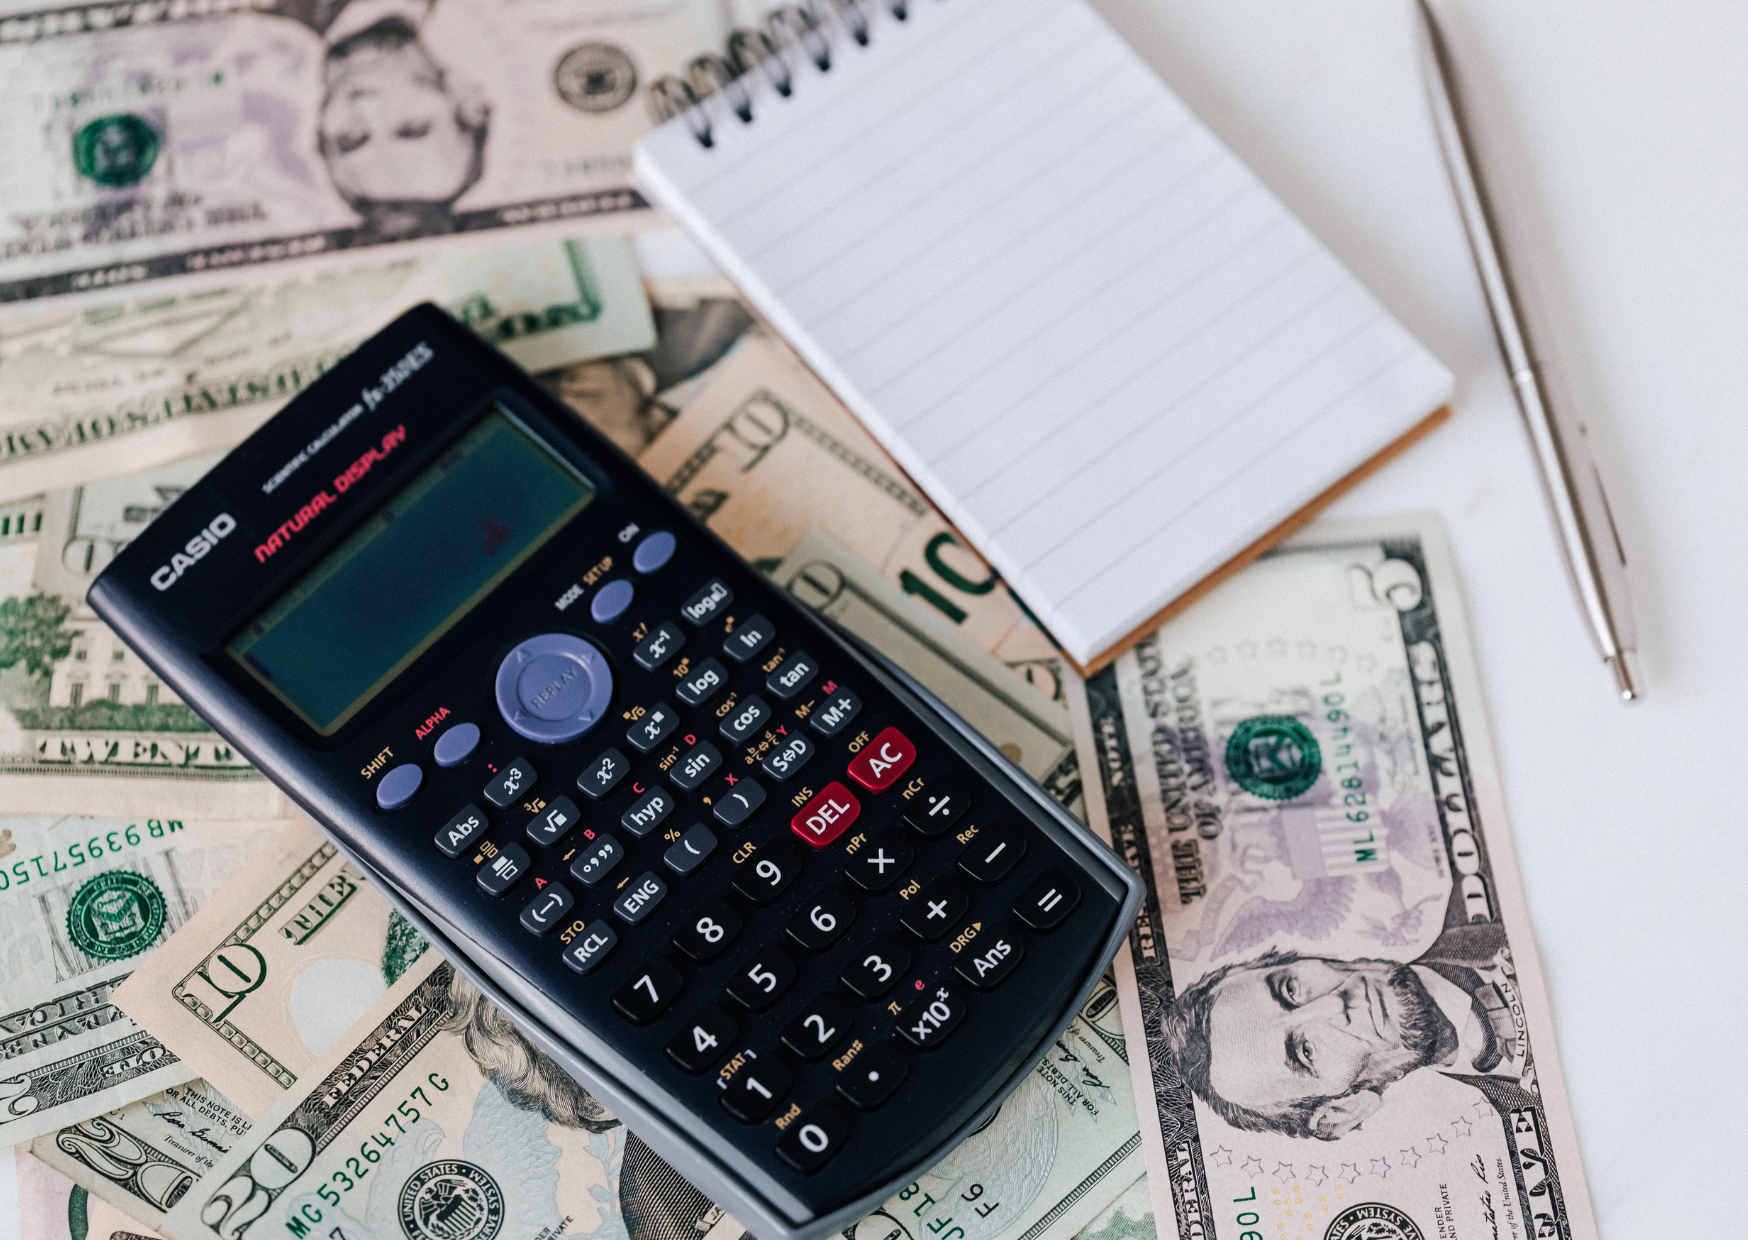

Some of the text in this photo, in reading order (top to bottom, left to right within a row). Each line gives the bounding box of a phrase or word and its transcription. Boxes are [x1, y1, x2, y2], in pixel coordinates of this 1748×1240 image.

[254, 424, 406, 563] NATURAL DISPLAY
[618, 522, 640, 543] ON
[150, 512, 237, 591] CASIO
[899, 532, 997, 625] 10
[1351, 557, 1423, 613] 5
[554, 583, 584, 611] MODE
[531, 665, 579, 710] REPLAY
[687, 668, 720, 695] log
[779, 661, 810, 688] tan
[822, 680, 838, 694] M
[415, 706, 451, 741] ALPHA
[734, 704, 761, 731] cos
[822, 695, 852, 727] M+
[684, 734, 697, 746] D
[776, 725, 789, 737] Y
[848, 731, 870, 753] OFF
[36, 735, 235, 768] TWENT
[361, 747, 394, 780] SHIFT
[684, 752, 710, 778] sin
[869, 742, 903, 778] AC
[633, 782, 645, 794] C
[902, 776, 926, 801] nCr
[1408, 640, 1492, 923] DOLLARS
[791, 787, 813, 808] INS
[630, 797, 664, 827] hyp
[806, 798, 850, 836] DEL
[447, 815, 480, 847] Abs
[583, 829, 596, 841] B
[664, 829, 681, 843] %
[845, 831, 868, 856] nPr
[957, 824, 980, 845] Rec
[732, 842, 756, 864] CLR
[534, 877, 547, 890] A
[756, 860, 782, 886] 9
[624, 880, 659, 914] ENG
[900, 880, 921, 900] Pol
[560, 920, 585, 944] STO
[696, 916, 724, 943] 8
[810, 905, 836, 932] 6
[574, 935, 608, 964] RCL
[973, 939, 1012, 977] Ans
[748, 962, 777, 992] 5
[863, 955, 892, 982] 3
[633, 974, 659, 1003] 7
[803, 1014, 836, 1044] 2
[1501, 983, 1527, 1058] LINCOLN
[692, 1025, 718, 1052] 4
[322, 1003, 431, 1108] FEDERAL
[746, 1077, 773, 1099] 1
[1037, 1067, 1058, 1088] NOTE
[166, 1087, 178, 1098] OR
[180, 1096, 196, 1110] ALL
[185, 1087, 242, 1124] THIS NOTE IS
[1057, 1086, 1076, 1106] THIS
[1069, 1085, 1084, 1100] ALL
[775, 1103, 801, 1130] Rnd
[1082, 1099, 1099, 1116] FOR
[164, 1134, 196, 1158] Treasurer
[799, 1124, 829, 1153] 0
[402, 1164, 458, 1220] UNITED STATES
[468, 1169, 499, 1209] SYSTEM
[1175, 1140, 1204, 1240] DERAL
[1439, 1183, 1452, 1217] PRIVATE
[1502, 1181, 1512, 1208] United
[1357, 1207, 1402, 1226] SYSTEM
[1435, 1206, 1447, 1240] ENDER
